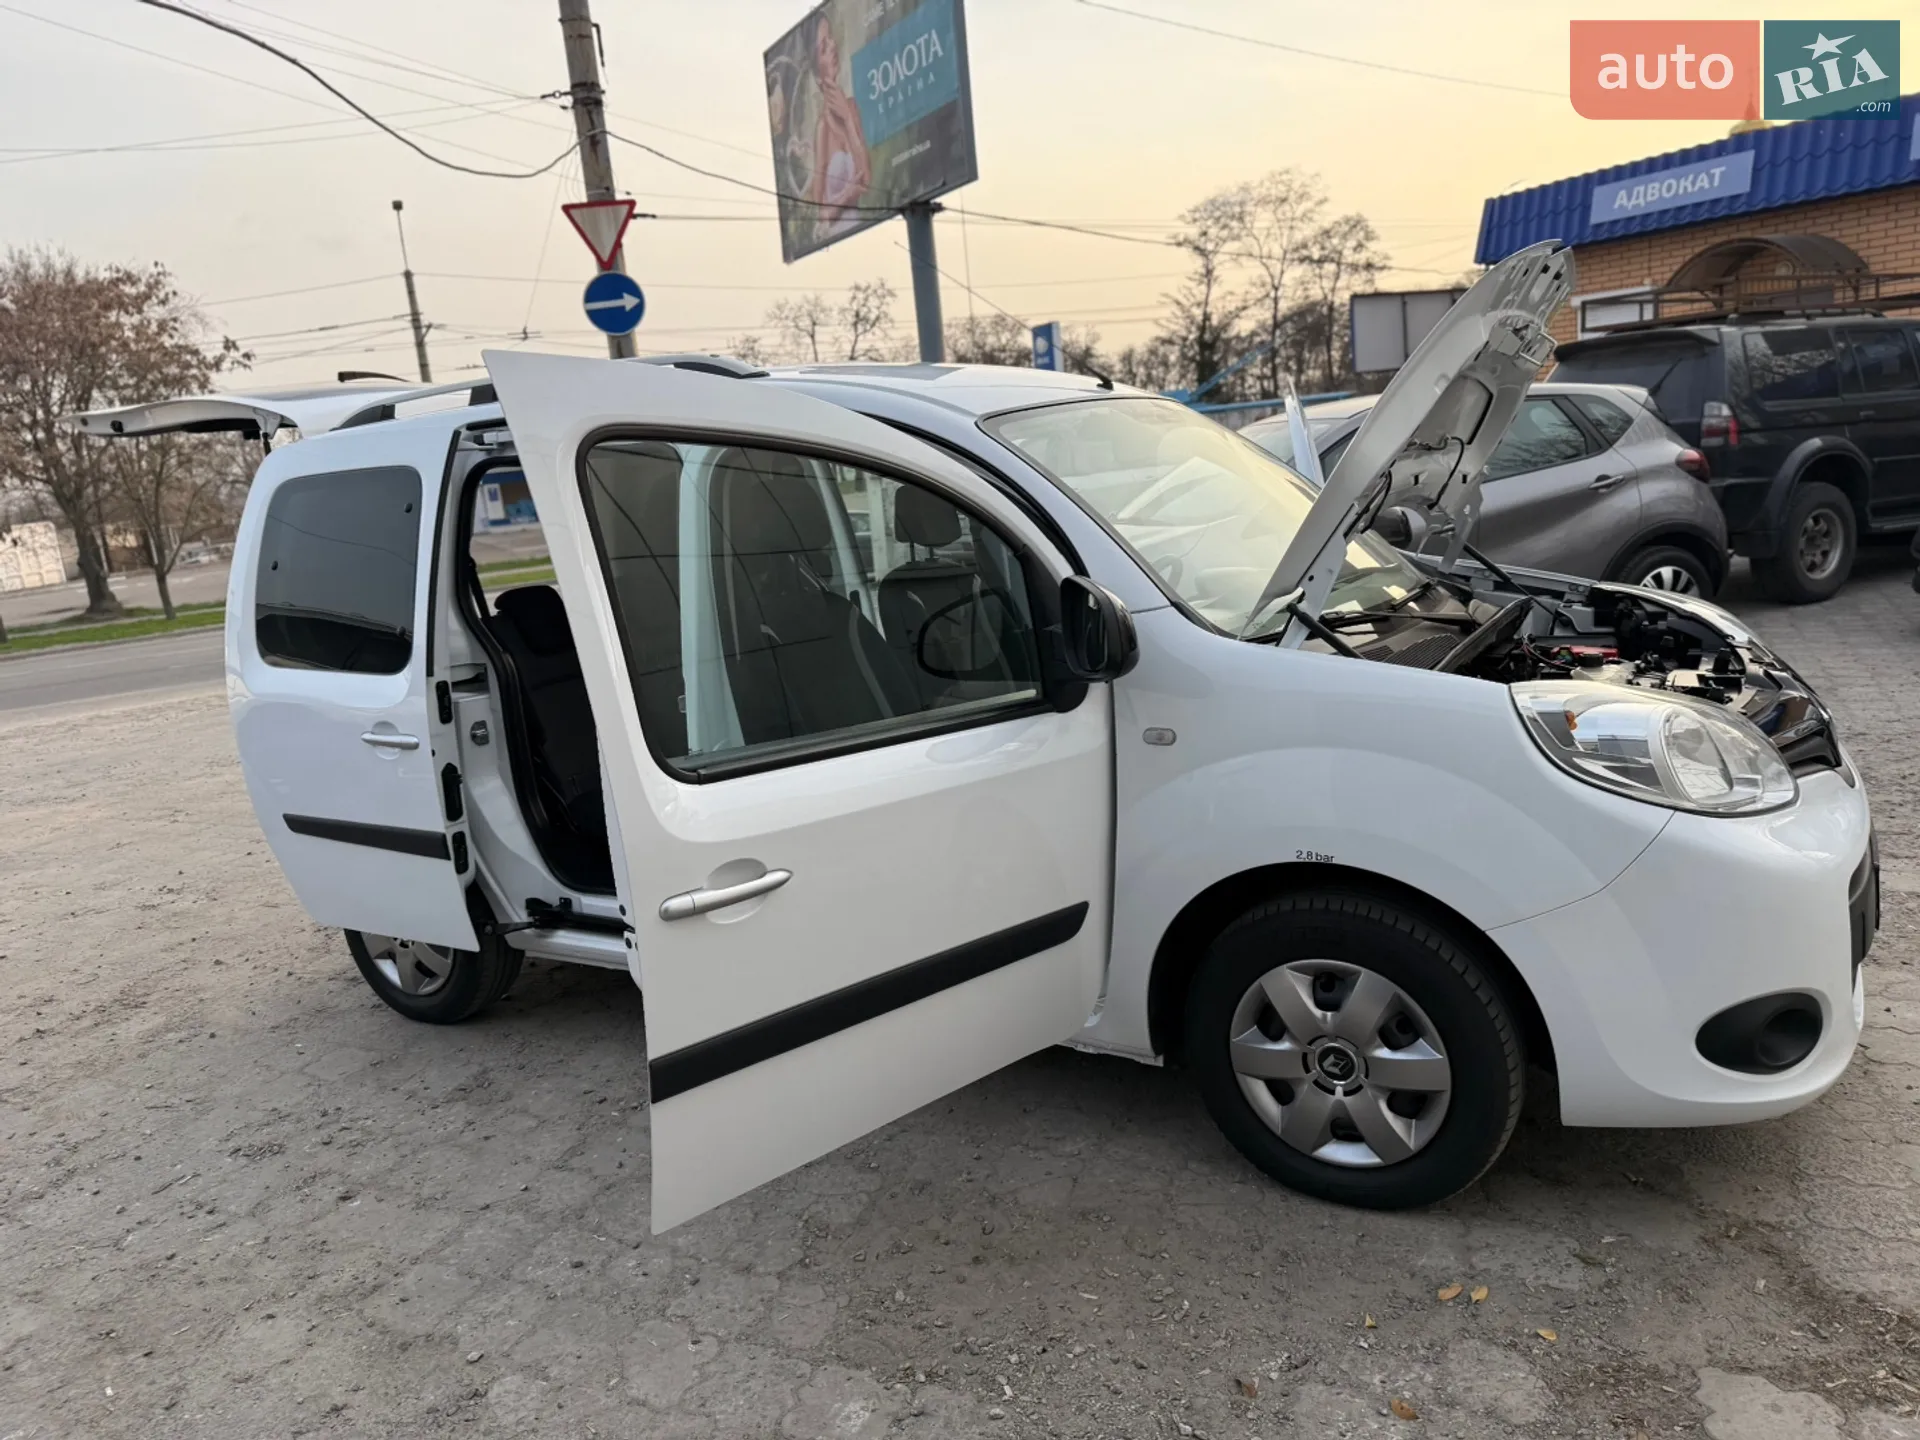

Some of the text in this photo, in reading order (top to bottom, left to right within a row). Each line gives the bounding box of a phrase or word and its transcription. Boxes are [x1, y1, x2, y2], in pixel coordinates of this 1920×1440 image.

[867, 28, 944, 100] ЗОЛОТА
[1613, 166, 1727, 210] АДВОКАТ
[1295, 849, 1335, 863] 2,8 bar
